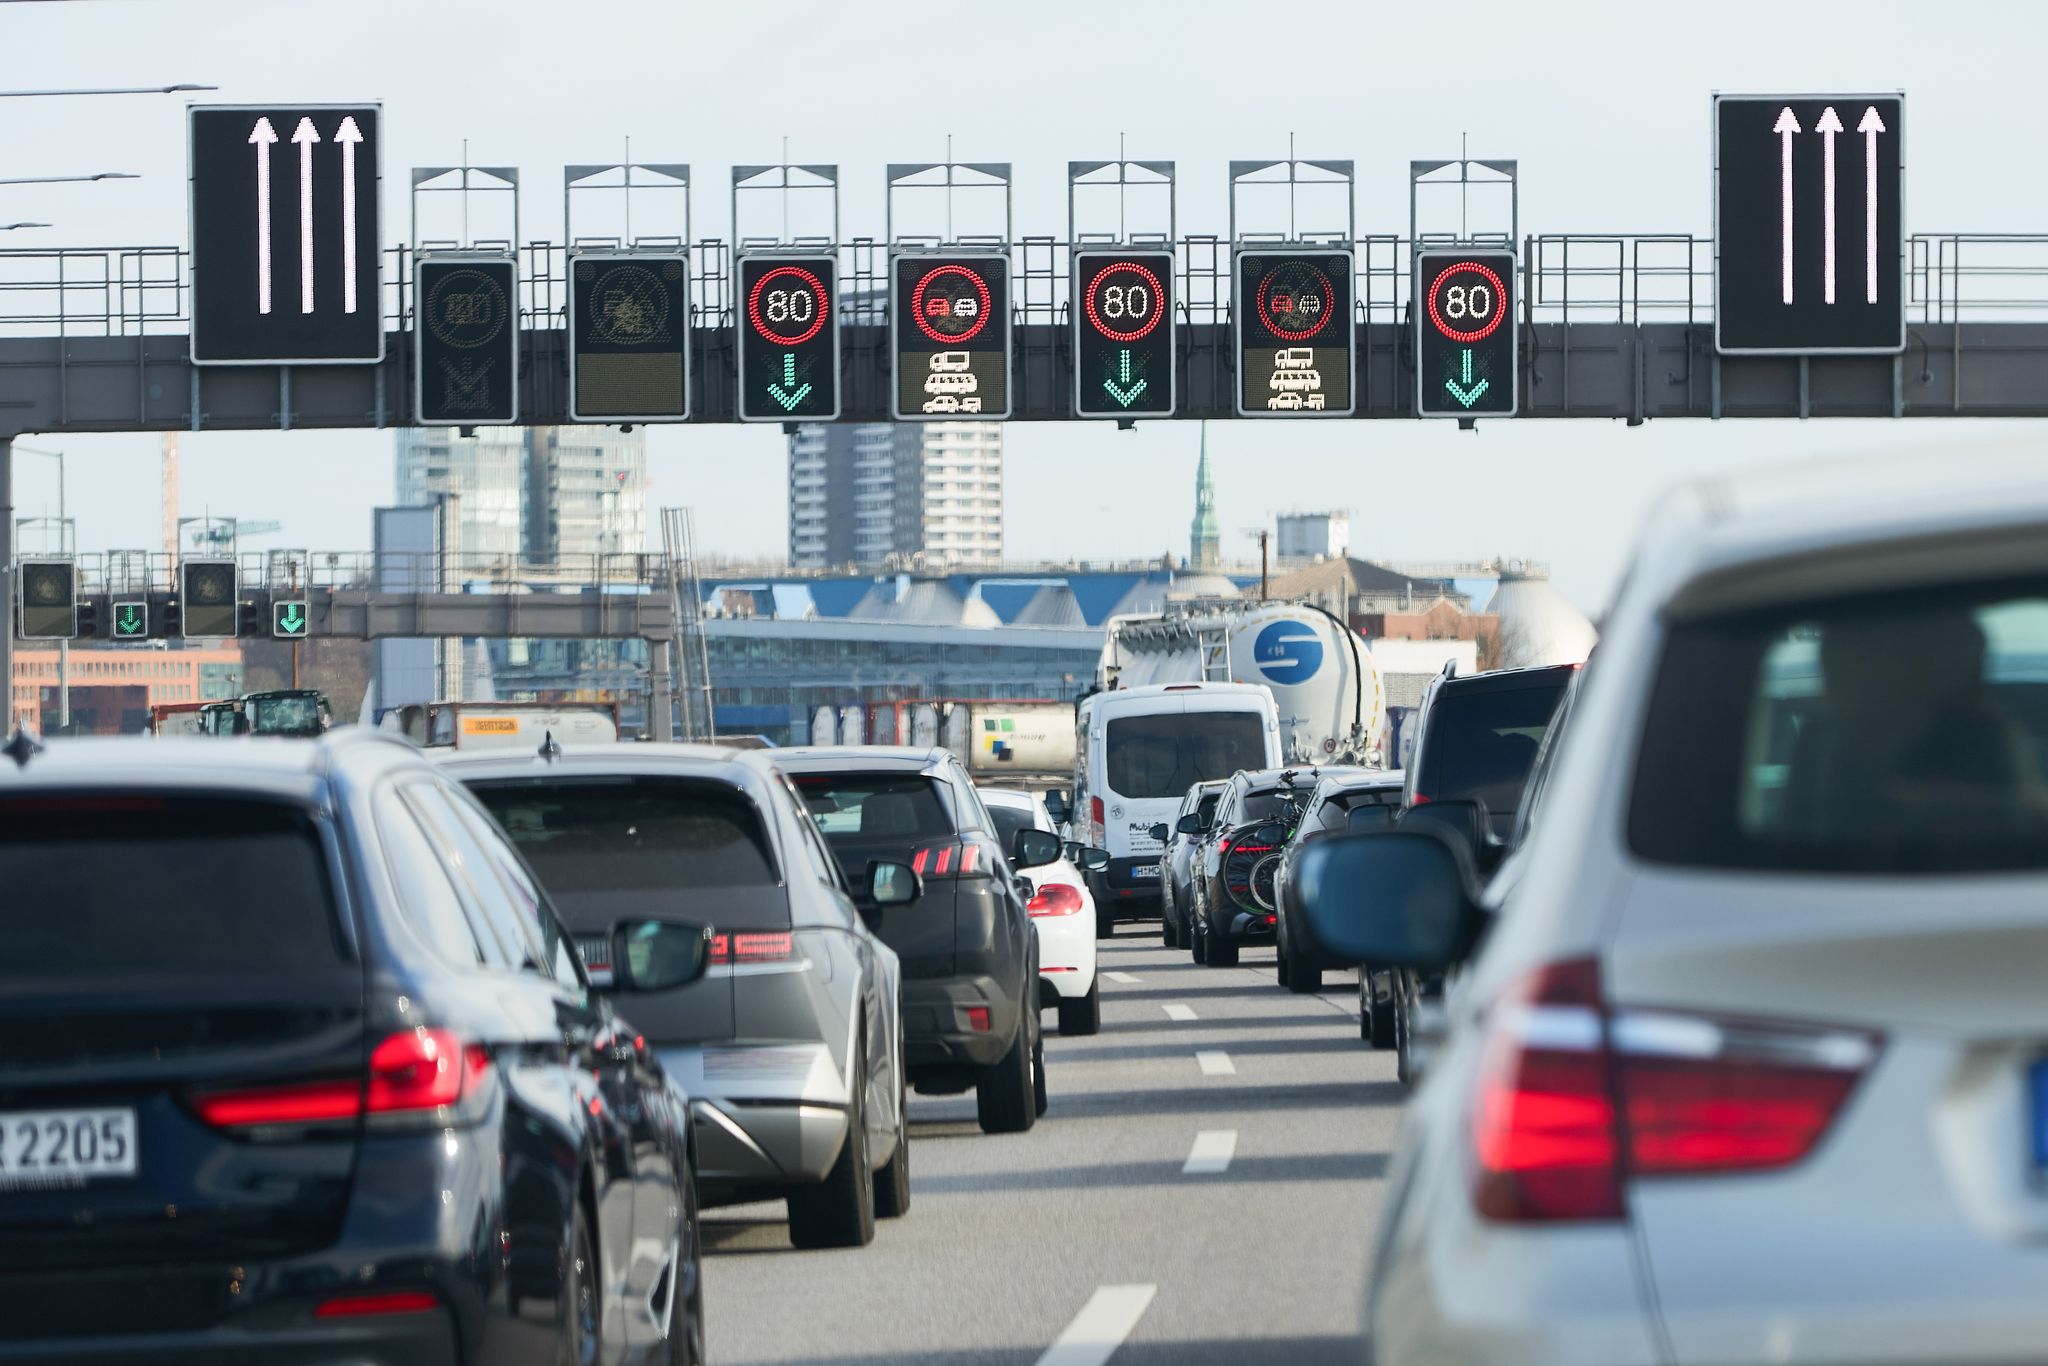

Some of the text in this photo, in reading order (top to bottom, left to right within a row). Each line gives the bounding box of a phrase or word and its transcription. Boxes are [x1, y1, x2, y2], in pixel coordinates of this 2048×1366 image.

[766, 288, 812, 323] 80
[1103, 285, 1148, 319] 80
[1446, 285, 1491, 319] 80
[17, 1116, 127, 1167] 2205
